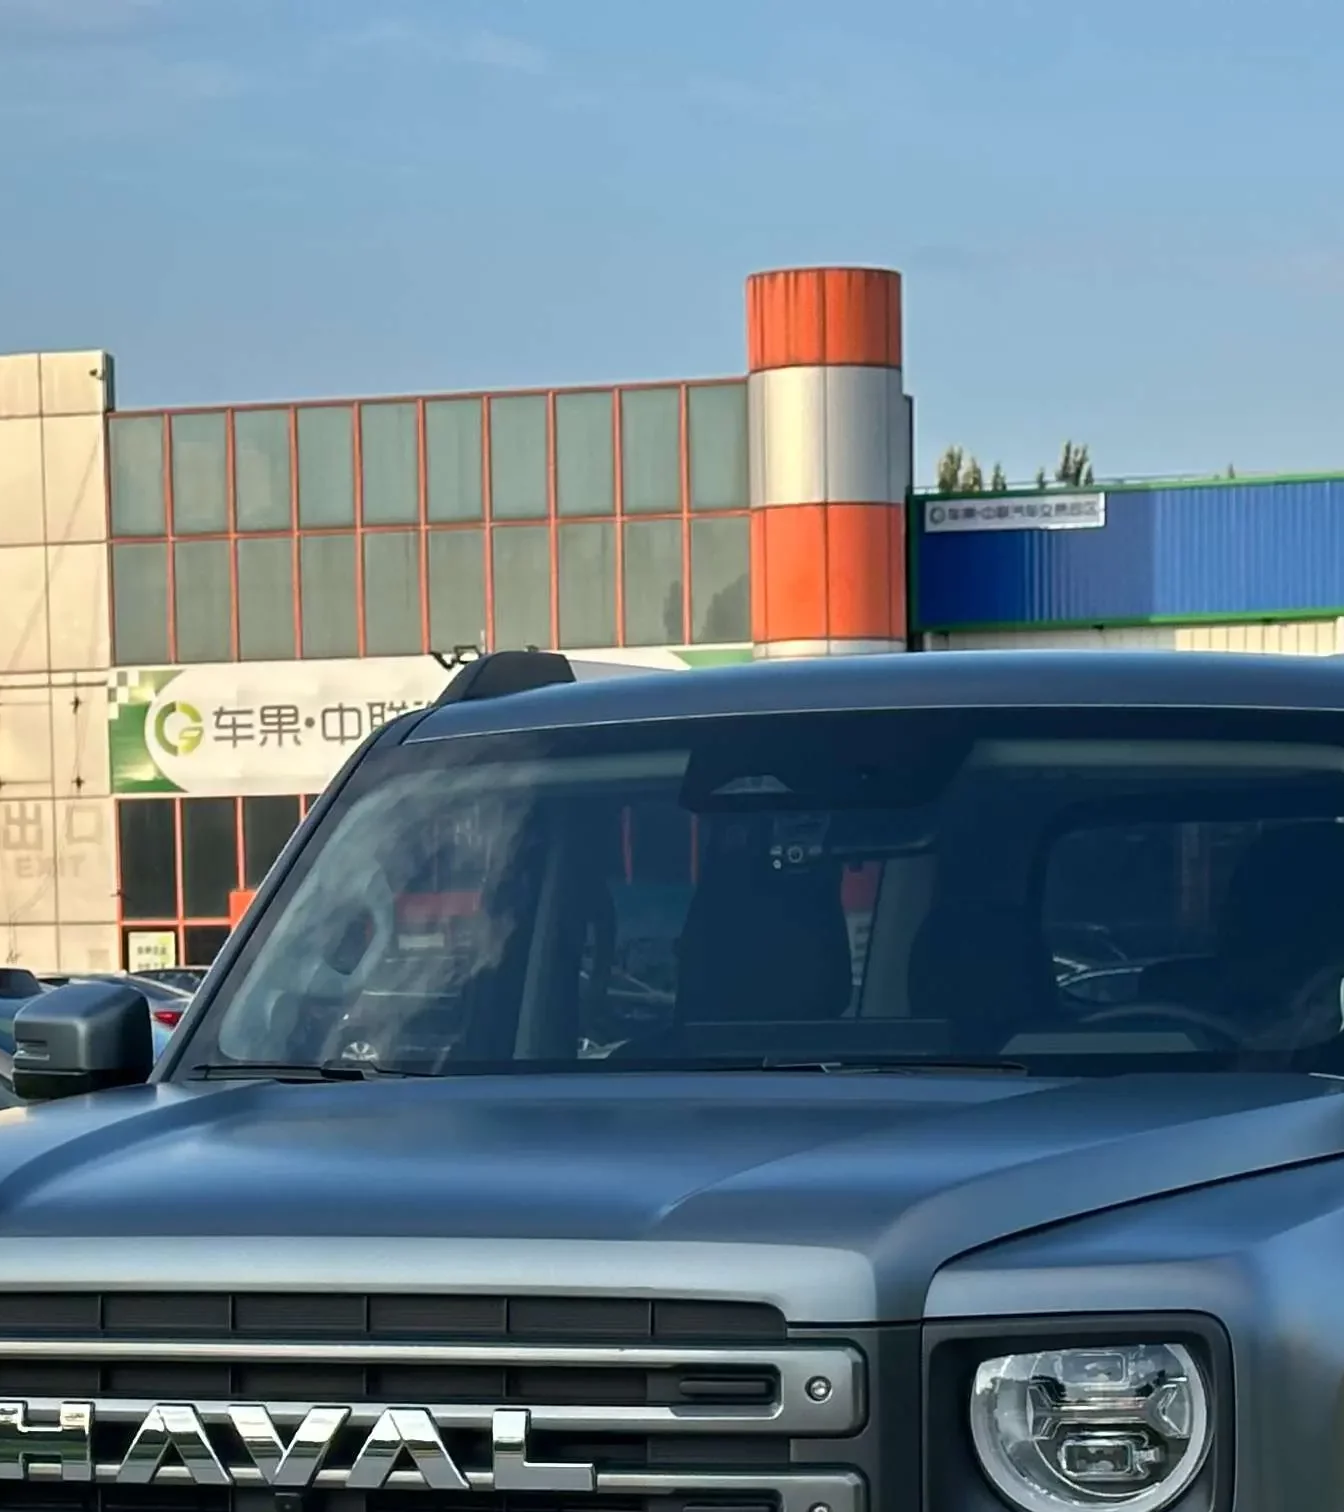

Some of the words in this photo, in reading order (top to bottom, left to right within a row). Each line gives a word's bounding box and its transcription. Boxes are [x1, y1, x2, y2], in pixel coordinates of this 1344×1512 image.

[213, 701, 433, 747] 车果·中联
[16, 855, 86, 879] EXIT
